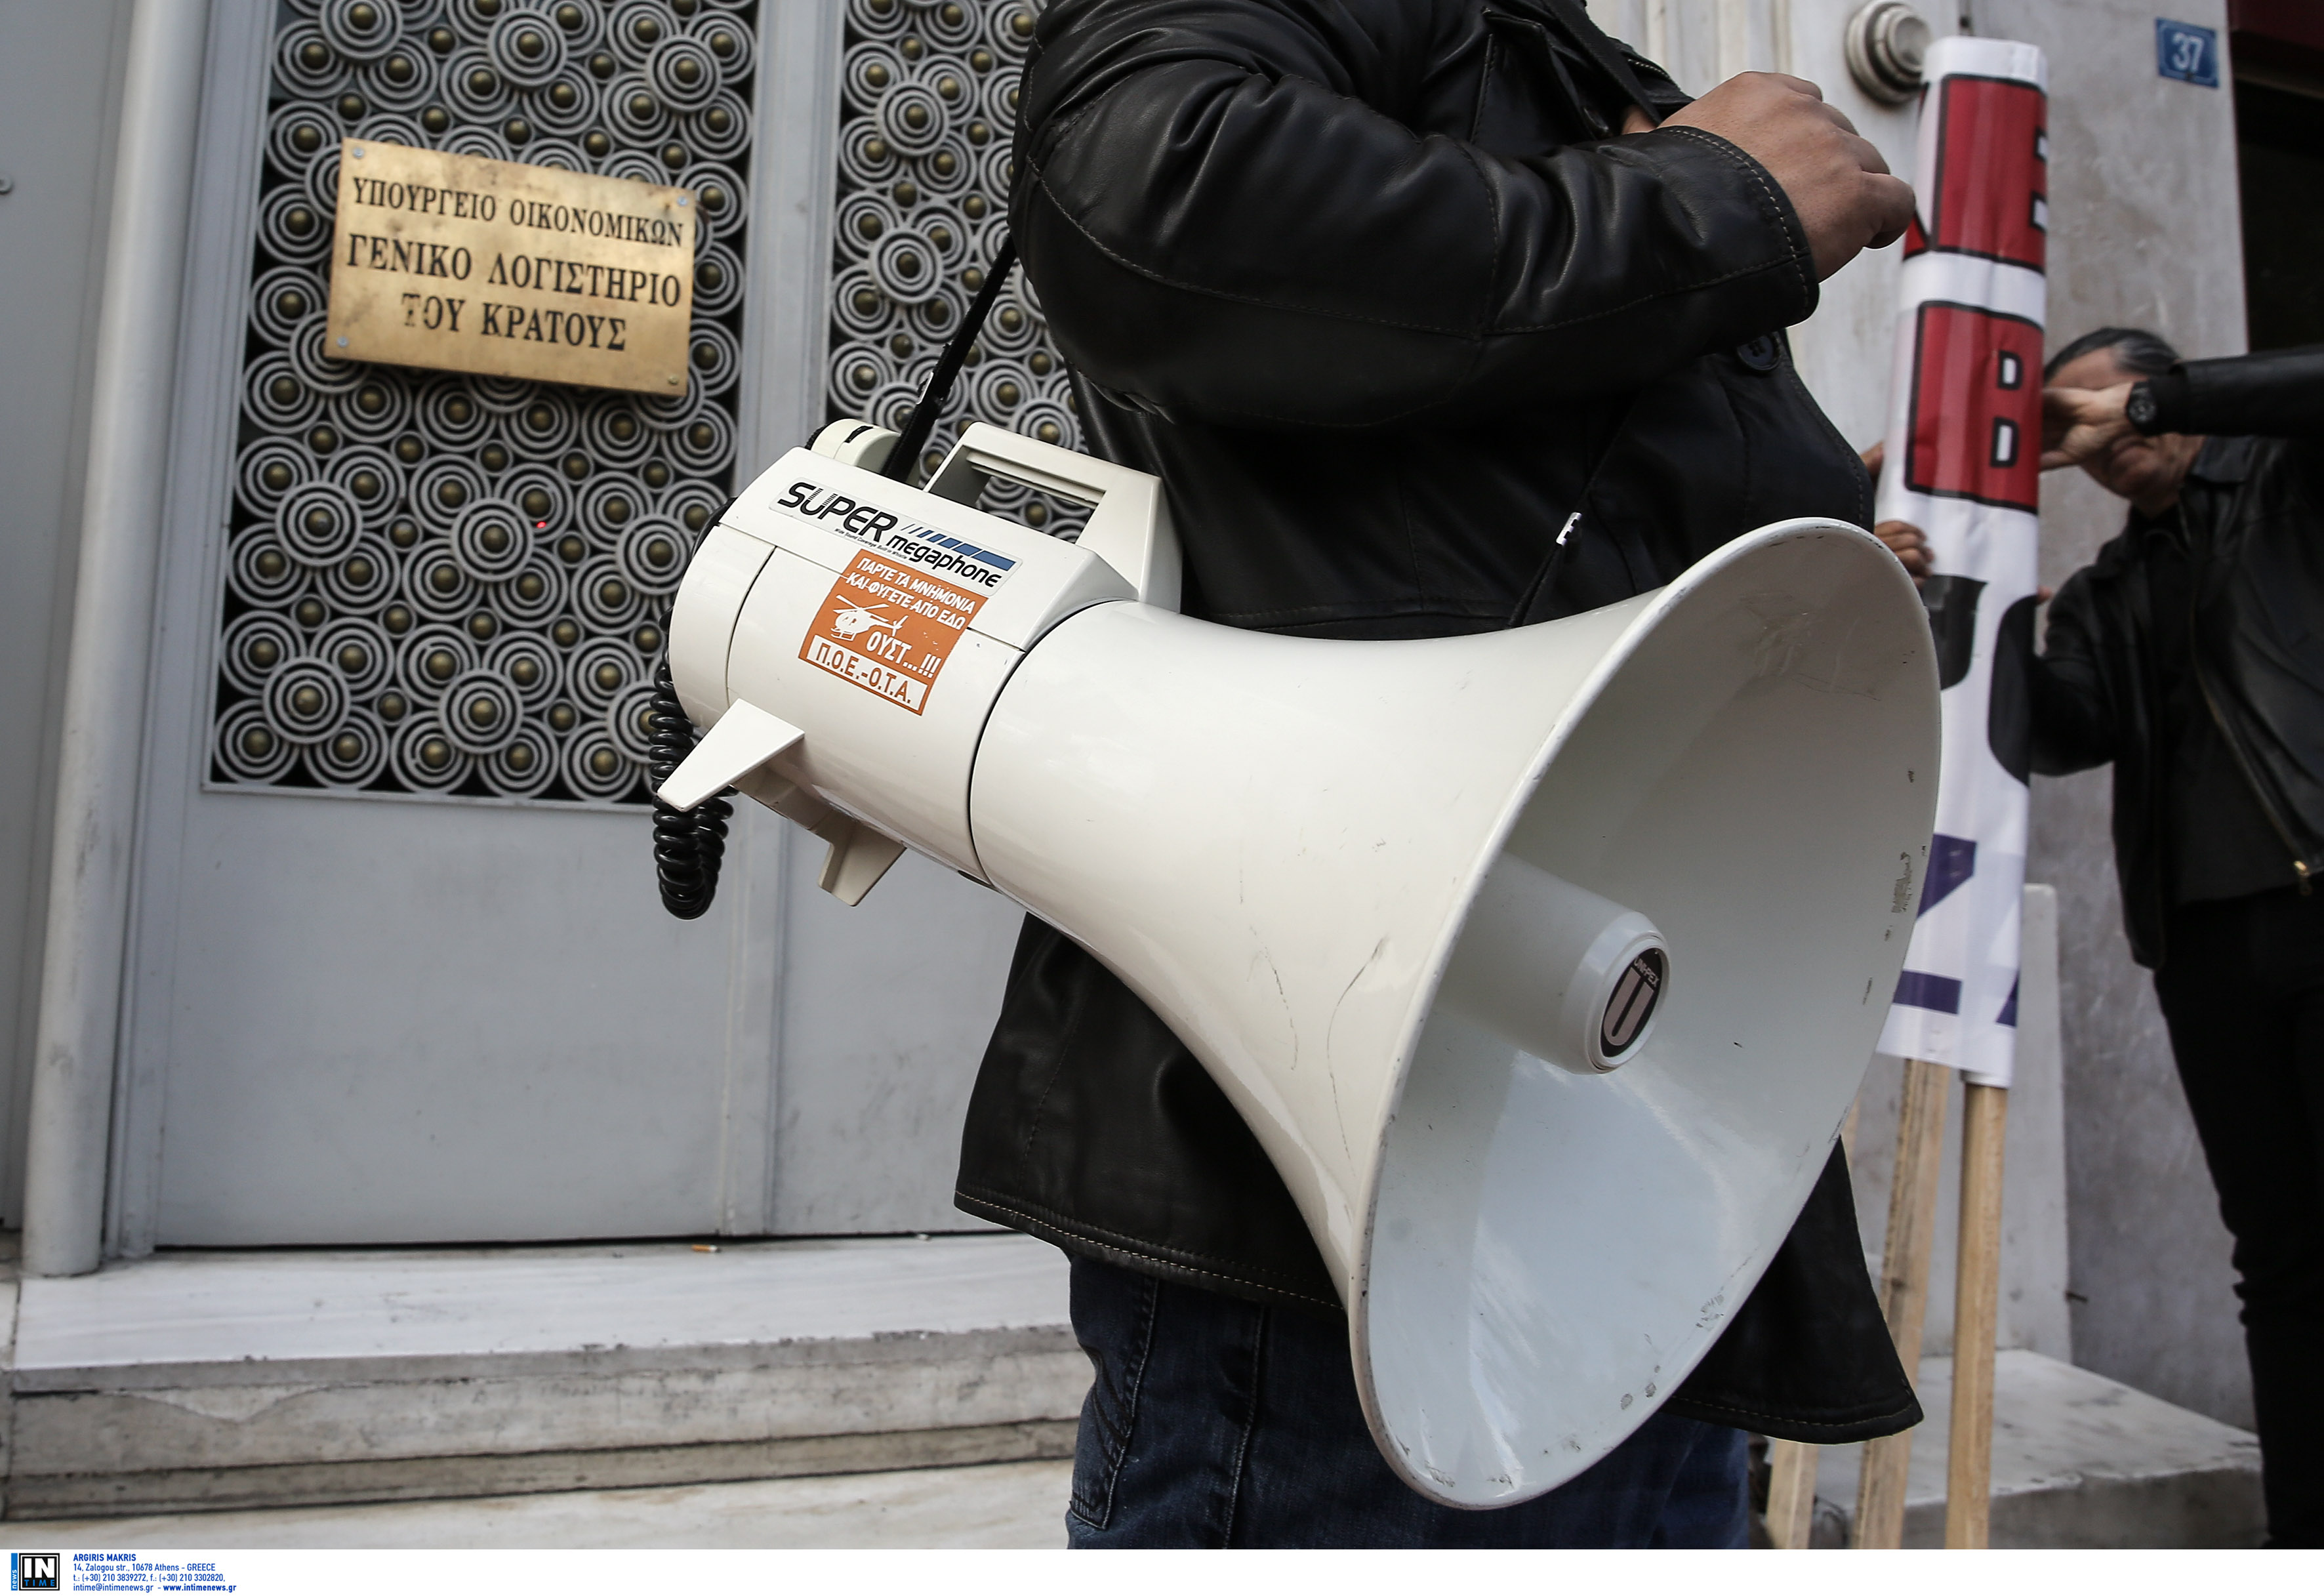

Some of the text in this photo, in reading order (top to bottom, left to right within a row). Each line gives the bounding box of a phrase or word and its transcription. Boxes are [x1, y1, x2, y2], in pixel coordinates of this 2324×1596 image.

[2172, 32, 2204, 71] 37
[354, 177, 683, 247] ΥΠΟΥΡΓΕΙΟ ΟΙΚΟΝΟΜΙΚΩΝ
[346, 233, 680, 307] ΓΕΝΙΚΟ ΛΟΓΙΣΤΗΡΙΟ
[401, 293, 626, 351] ΤΟΥ ΚΡΑΤΟΥΣ
[777, 481, 898, 542] SUPER
[857, 558, 976, 614] ΠΑΡΤΕ ΤΑ ΜΝΗΜΟΝΙΑ
[886, 535, 1002, 588] megaphone
[846, 572, 966, 630] ΚΑΙ ΦΥΓΕΤΕ ΑΠΟ ΕΔΩ
